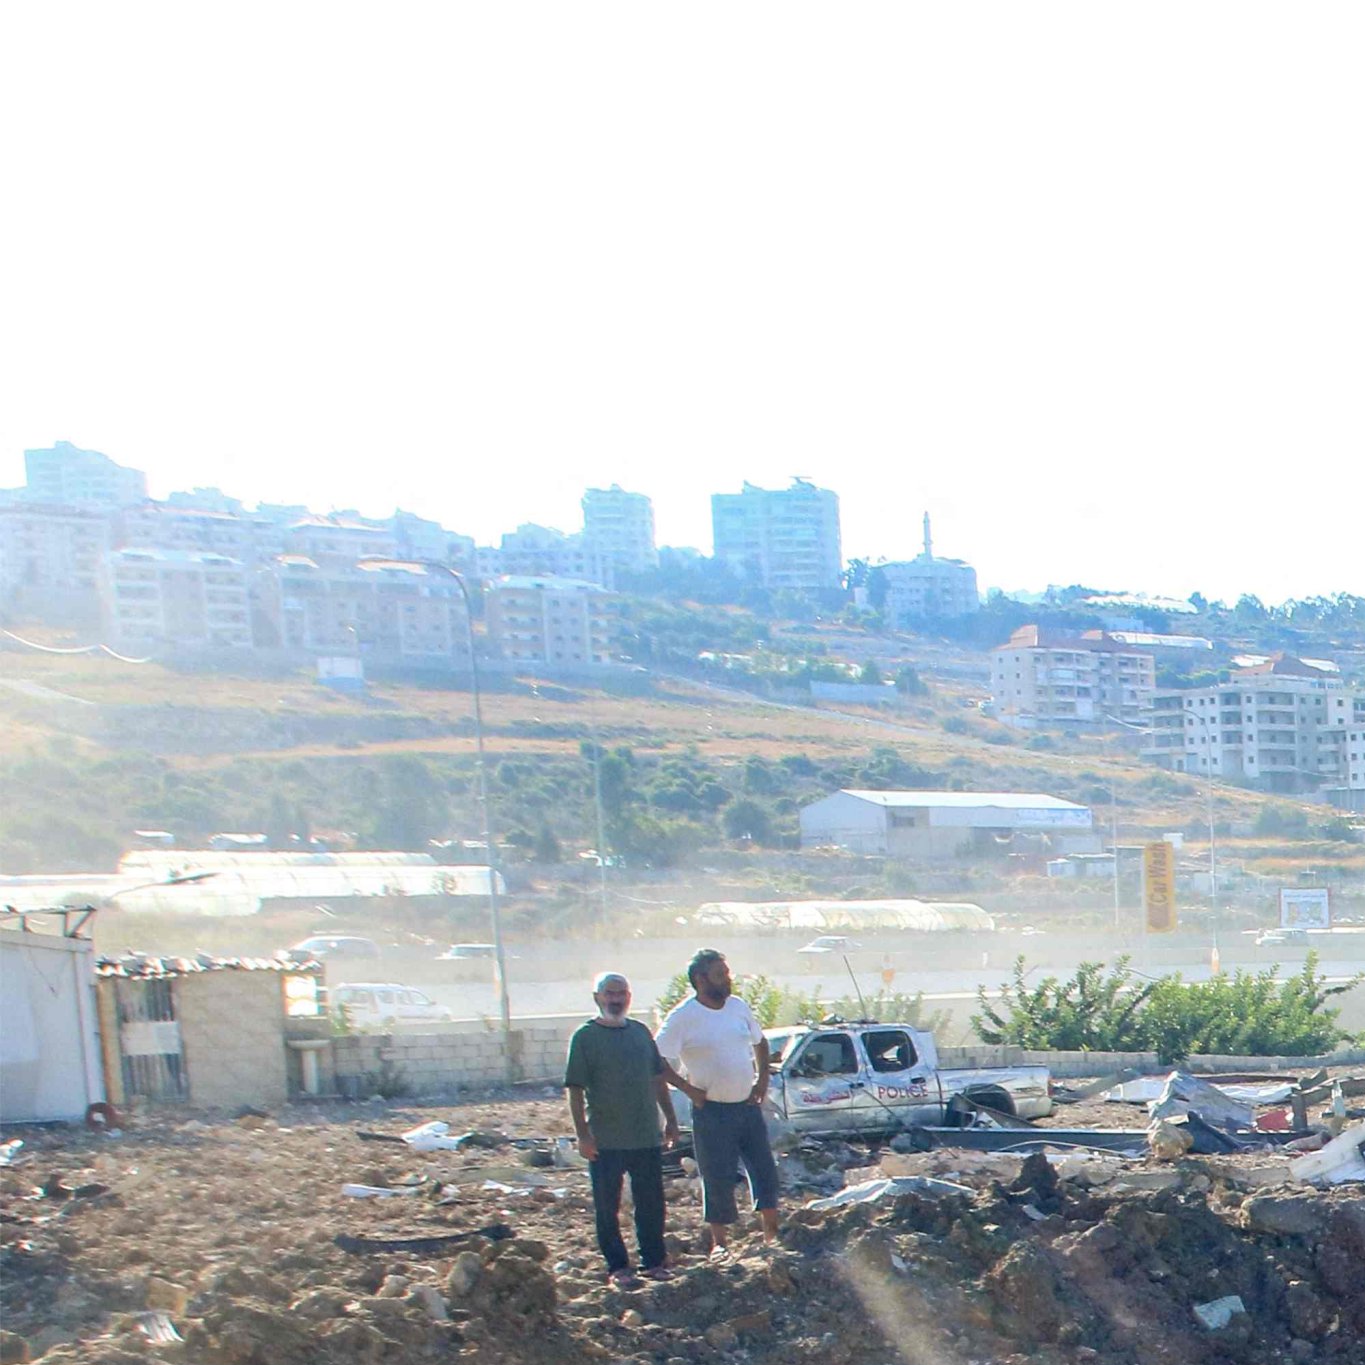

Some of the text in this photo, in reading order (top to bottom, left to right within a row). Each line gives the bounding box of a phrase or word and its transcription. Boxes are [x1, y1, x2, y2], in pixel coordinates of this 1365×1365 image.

[1148, 843, 1168, 904] Car Wash
[877, 1085, 929, 1099] POLICE
